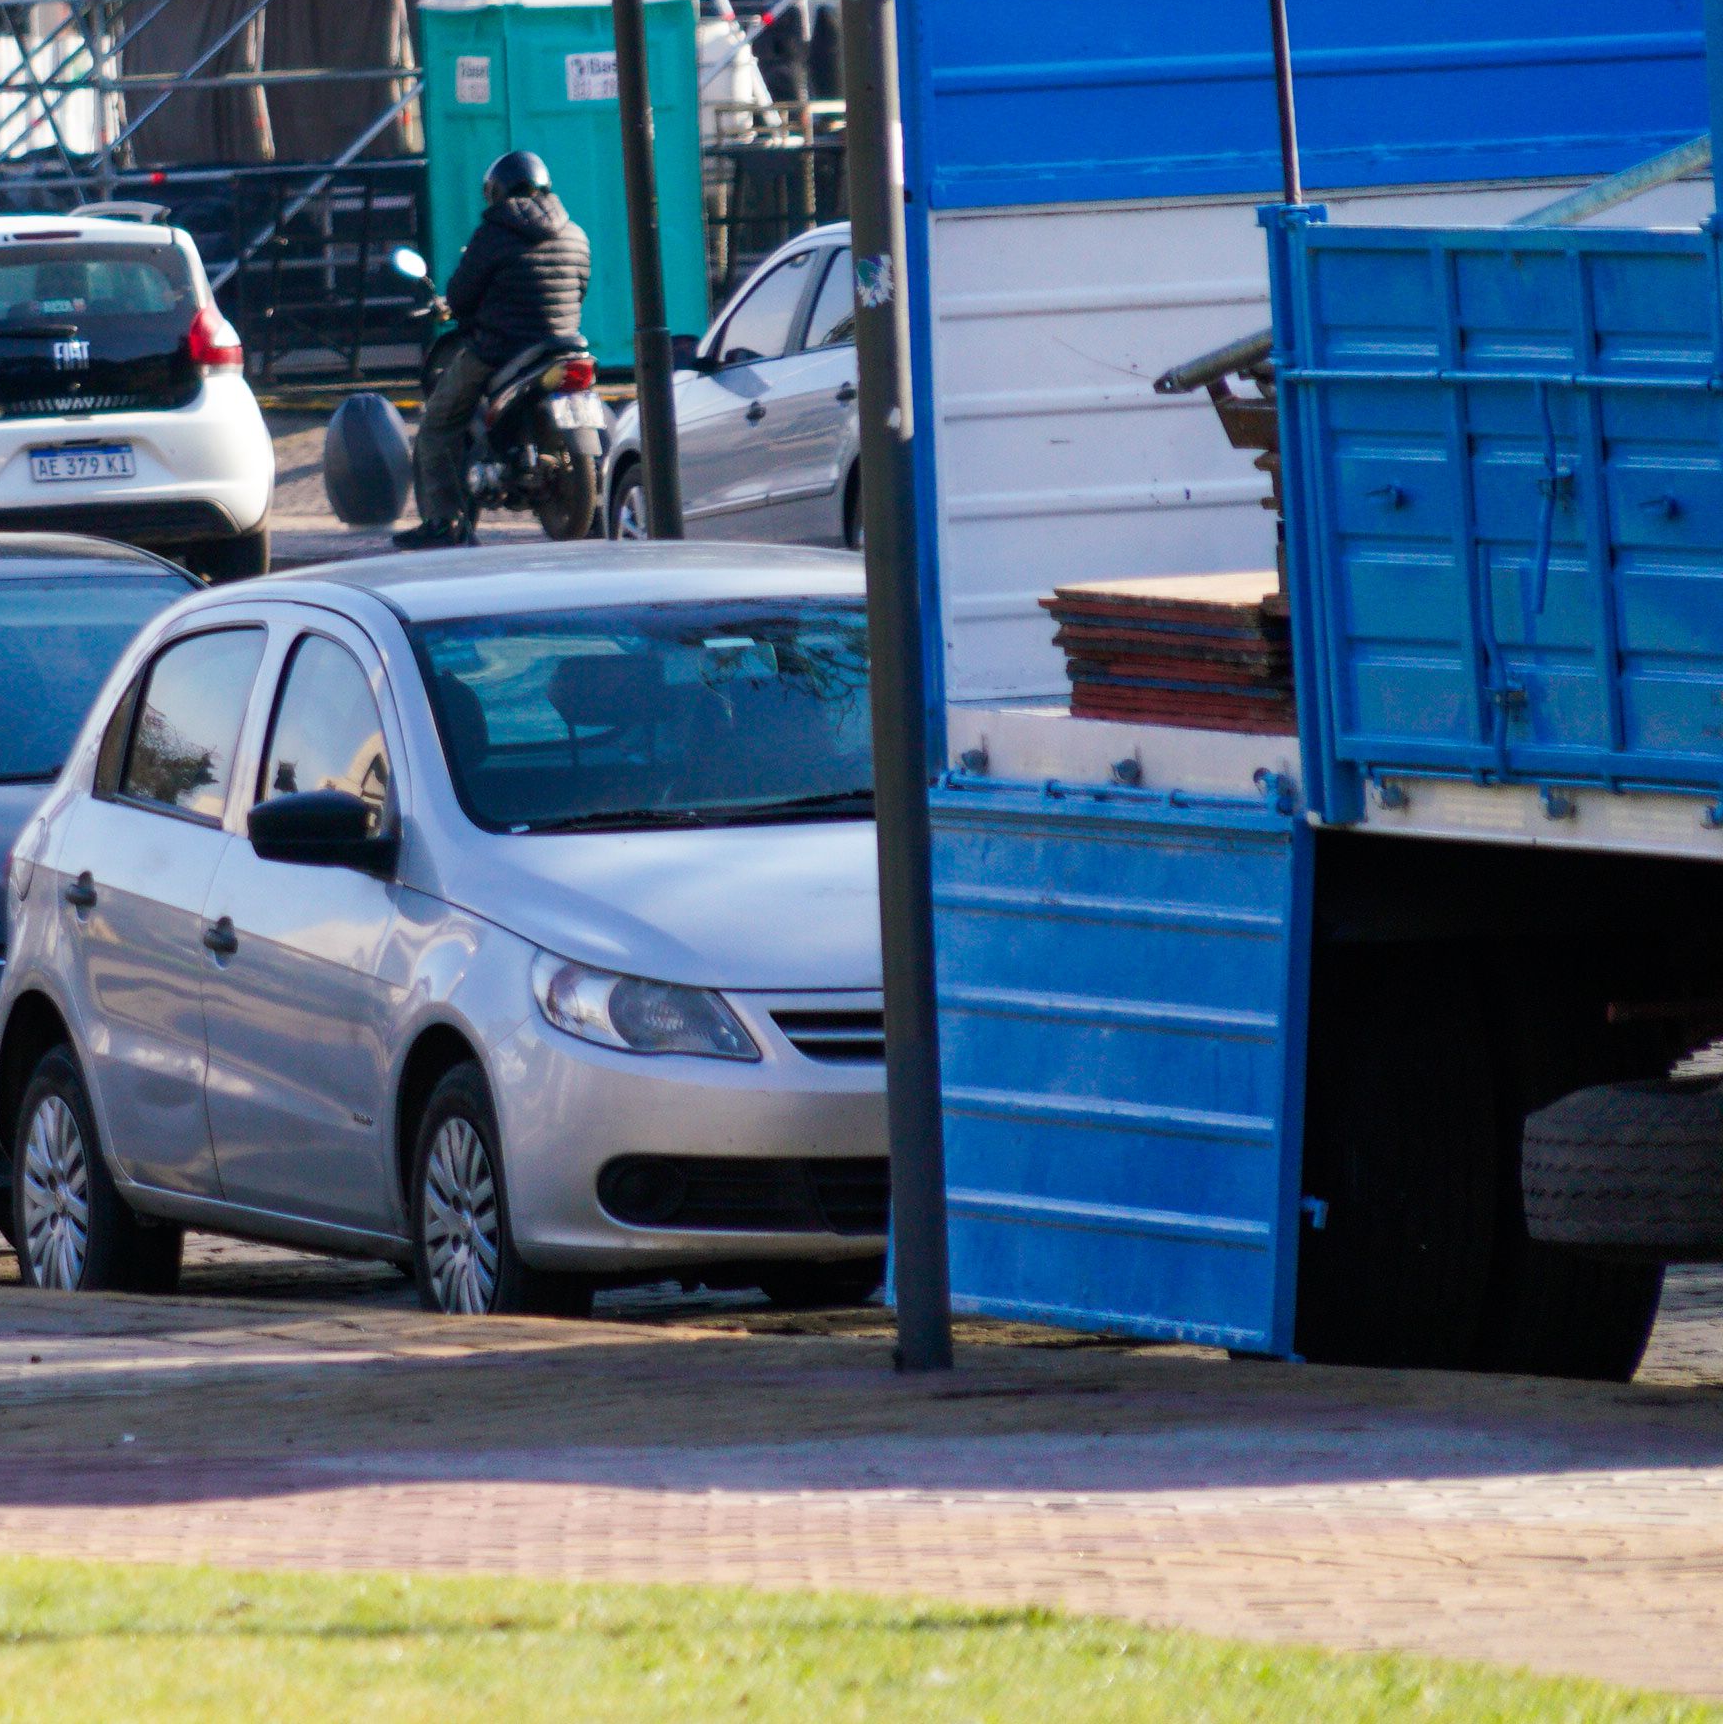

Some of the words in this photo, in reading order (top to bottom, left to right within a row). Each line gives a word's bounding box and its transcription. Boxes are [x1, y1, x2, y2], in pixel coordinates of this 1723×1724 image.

[53, 341, 90, 360] FIAT
[38, 458, 60, 477] AE
[66, 456, 100, 475] 379
